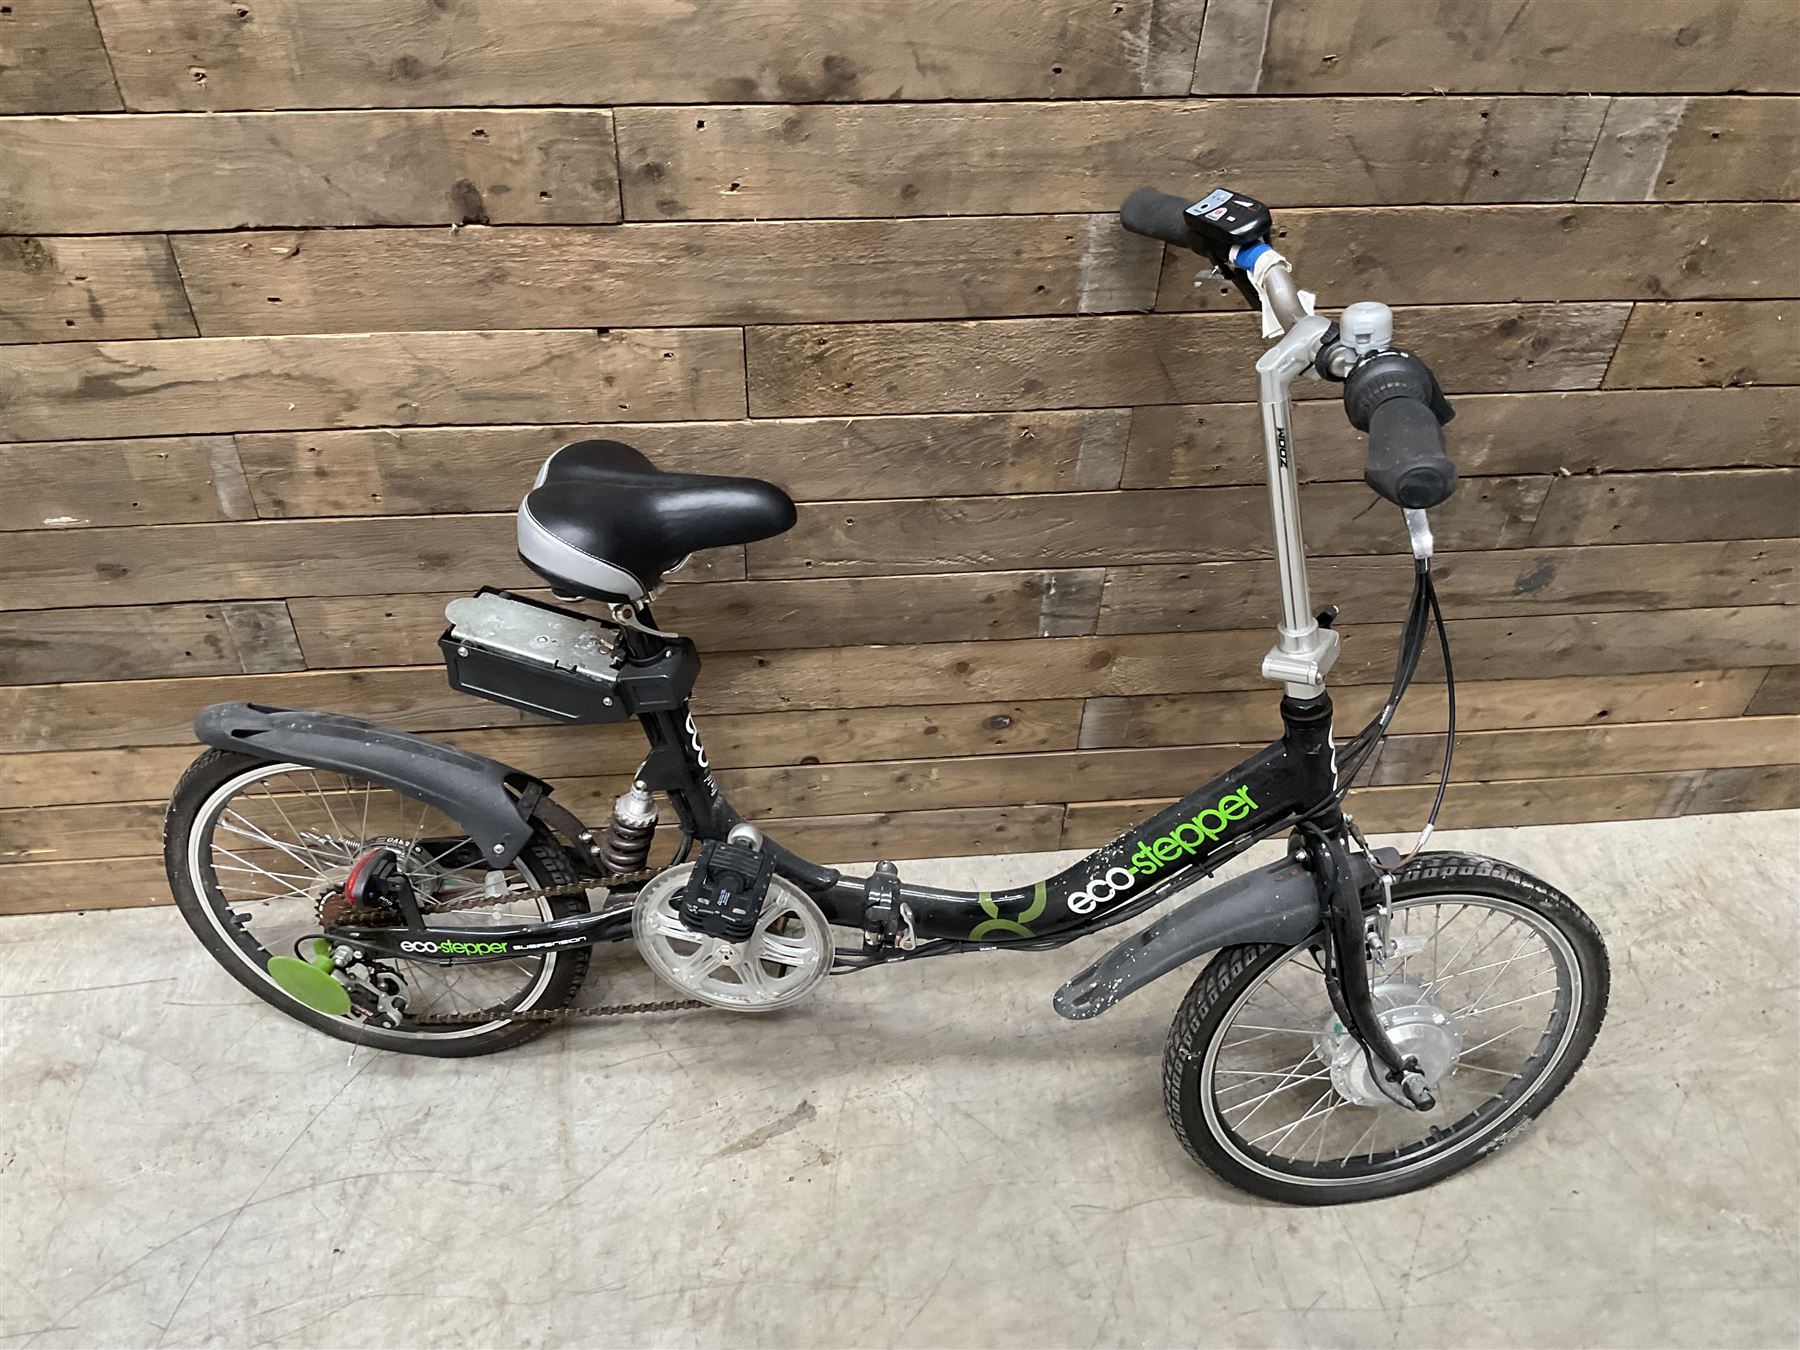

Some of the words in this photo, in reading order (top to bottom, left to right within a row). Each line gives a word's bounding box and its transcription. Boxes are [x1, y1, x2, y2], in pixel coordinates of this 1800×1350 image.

[1277, 427, 1288, 468] ZOOM
[1067, 784, 1259, 914] eco-stepper
[400, 939, 507, 956] eco-stepper
